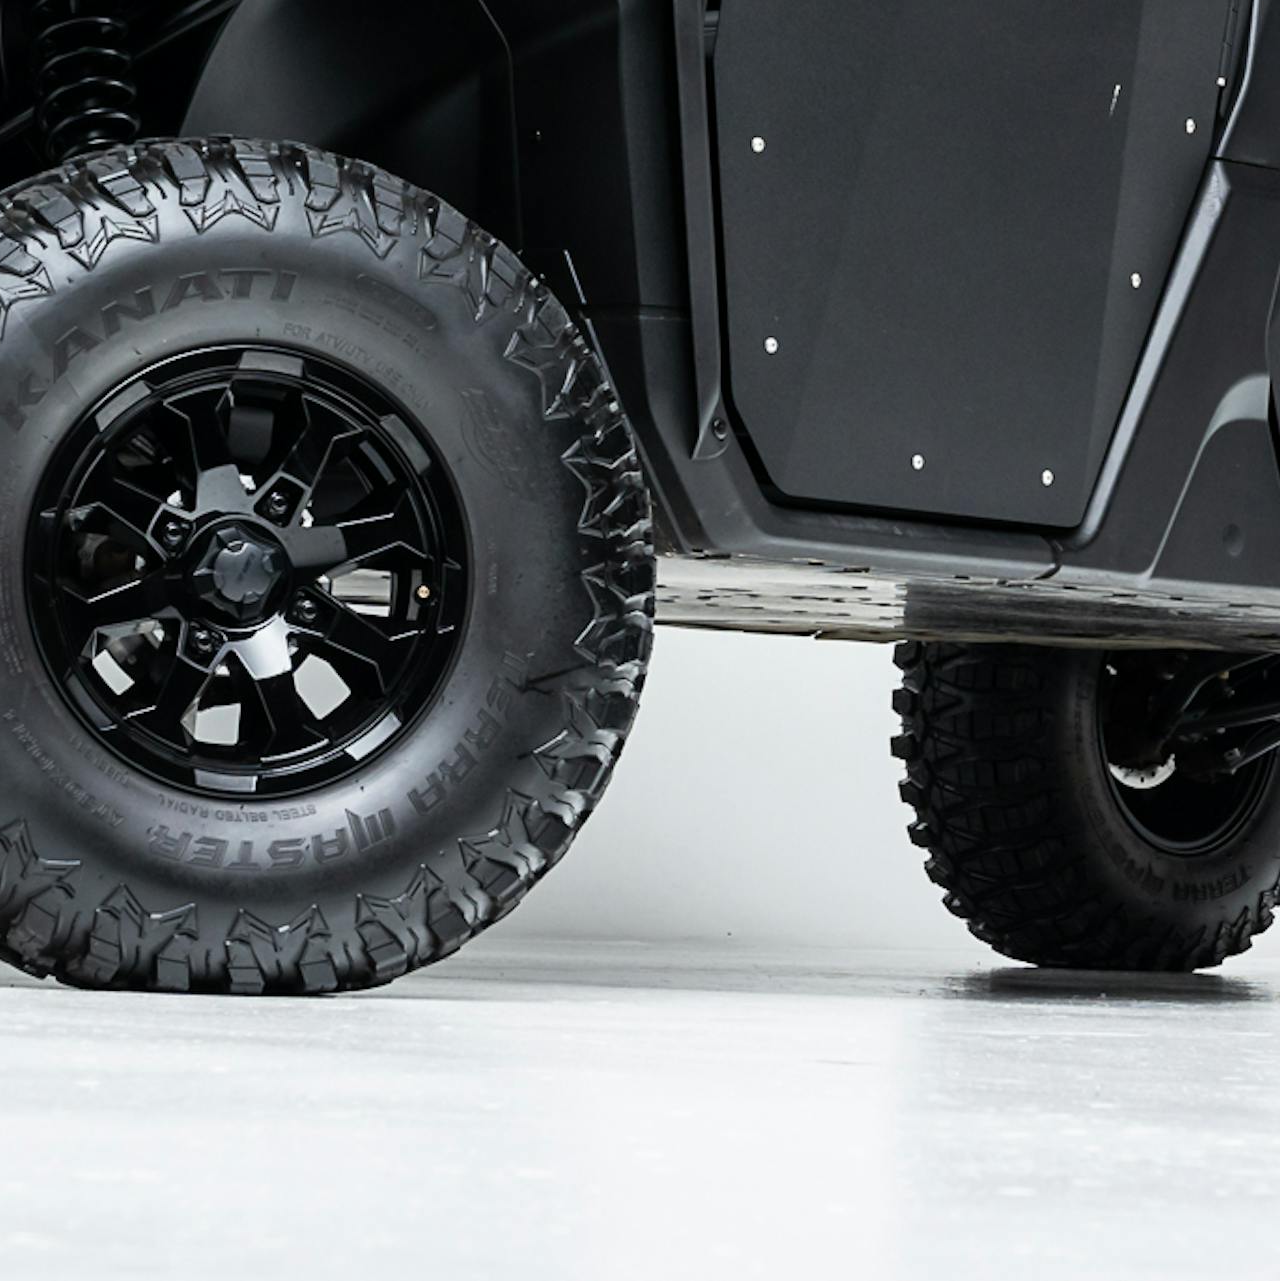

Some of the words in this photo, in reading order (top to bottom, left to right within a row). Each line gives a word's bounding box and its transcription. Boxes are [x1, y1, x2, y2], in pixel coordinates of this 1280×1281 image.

[283, 322, 312, 340] FOR
[0, 268, 297, 431] KANATI
[406, 649, 530, 814] TERRA
[158, 792, 210, 820] RADIAL
[215, 808, 269, 823] BELTED
[271, 803, 317, 820] STEEL
[148, 807, 399, 873] MASTER
